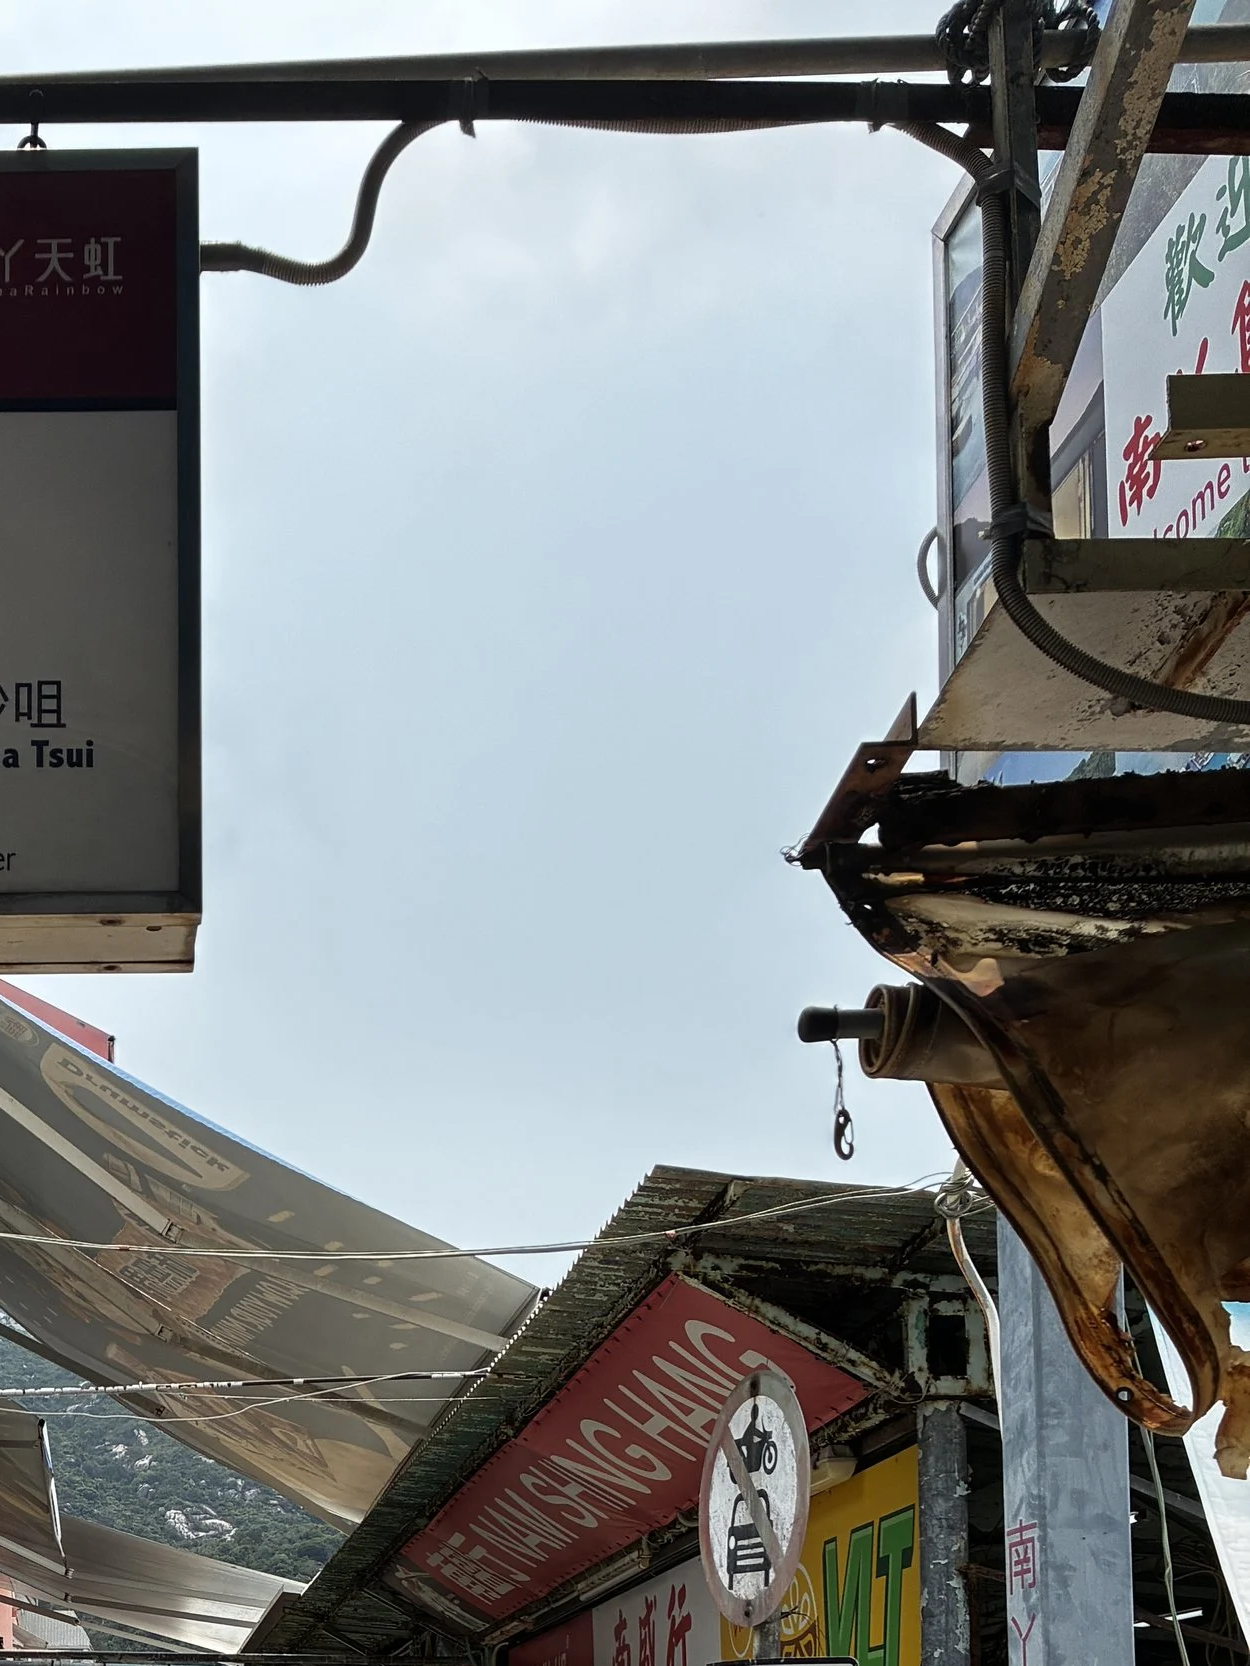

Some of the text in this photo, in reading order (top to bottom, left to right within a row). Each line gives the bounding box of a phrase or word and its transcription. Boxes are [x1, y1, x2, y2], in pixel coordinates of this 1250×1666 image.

[30, 739, 95, 768] Tsui
[603, 1319, 796, 1462] HANG
[519, 1418, 673, 1528] SHING
[469, 1487, 580, 1569] NAM
